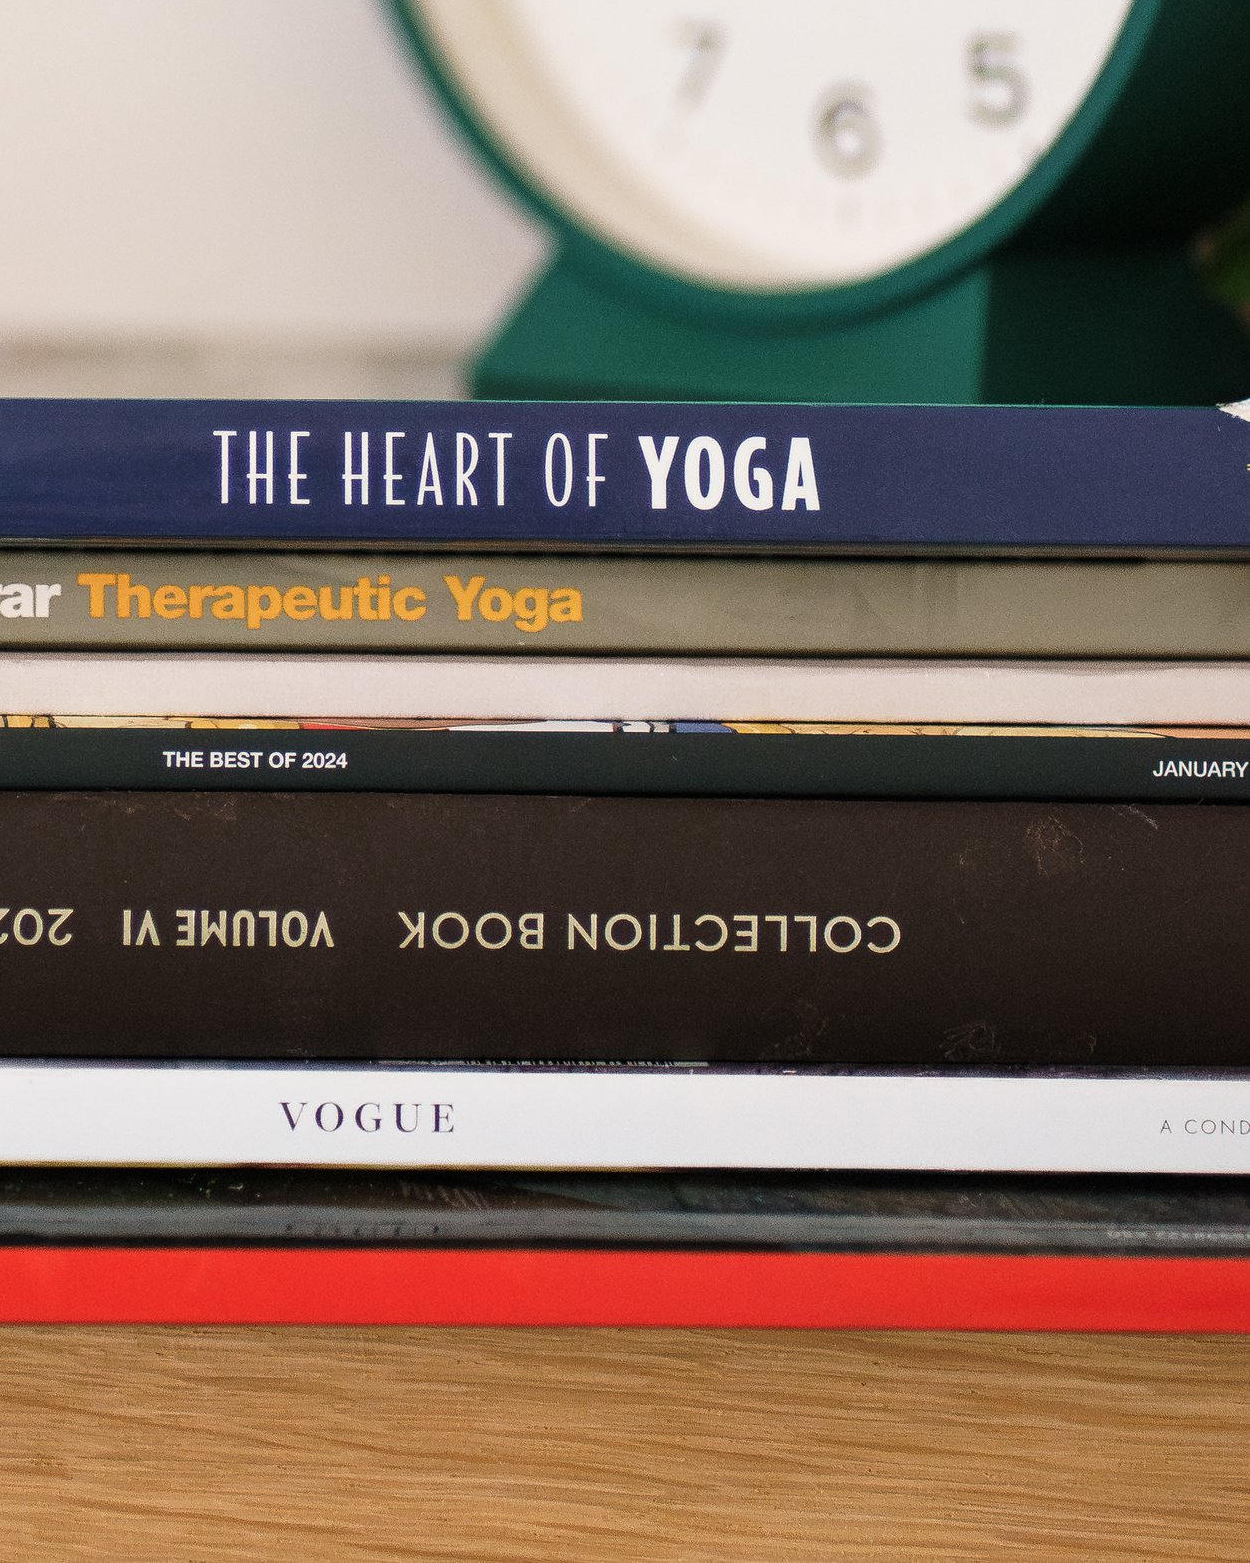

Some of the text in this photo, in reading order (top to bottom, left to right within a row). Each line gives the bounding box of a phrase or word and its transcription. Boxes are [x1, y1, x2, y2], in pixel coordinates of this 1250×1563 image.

[671, 19, 725, 109] 7
[966, 32, 1026, 125] 5
[813, 80, 880, 179] 6
[212, 430, 821, 511] THE HEART OF YOGA
[77, 573, 427, 630] Therapeutic
[443, 575, 584, 633] Yoga
[162, 751, 348, 769] THE BEST OF 2024
[1152, 760, 1249, 778] JANUARY
[122, 909, 161, 946] VI
[175, 909, 335, 948] VOLUME
[397, 911, 544, 950] BOOK
[567, 913, 901, 954] COLLECTION
[280, 1102, 456, 1134] VOGUE
[1159, 1119, 1250, 1135] A COND
